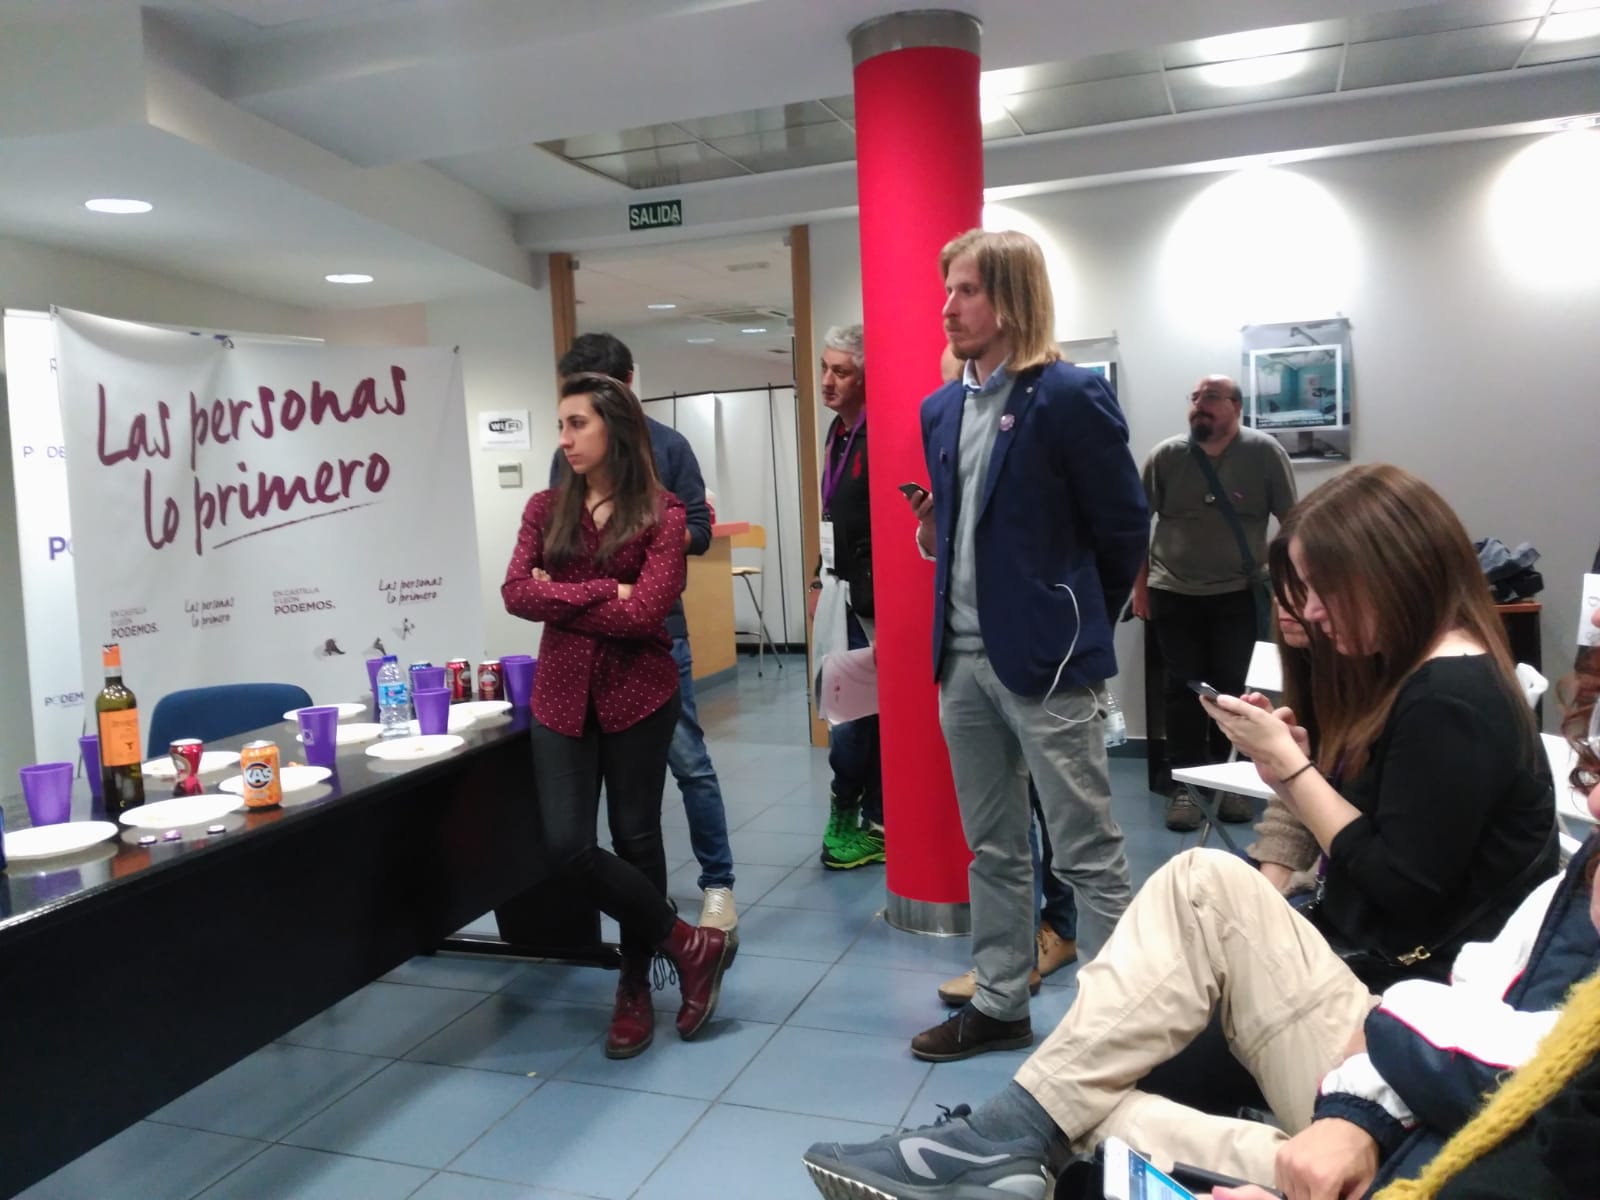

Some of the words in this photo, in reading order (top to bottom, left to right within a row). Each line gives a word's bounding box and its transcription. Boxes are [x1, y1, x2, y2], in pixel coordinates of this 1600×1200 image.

[630, 204, 681, 227] SALIDA
[97, 383, 170, 466] Las
[190, 365, 407, 472] personas
[145, 468, 179, 550] lo
[194, 452, 390, 557] primero
[378, 578, 396, 591] Las
[274, 600, 336, 615] PODEMOS.
[112, 622, 159, 638] PODEMOS.
